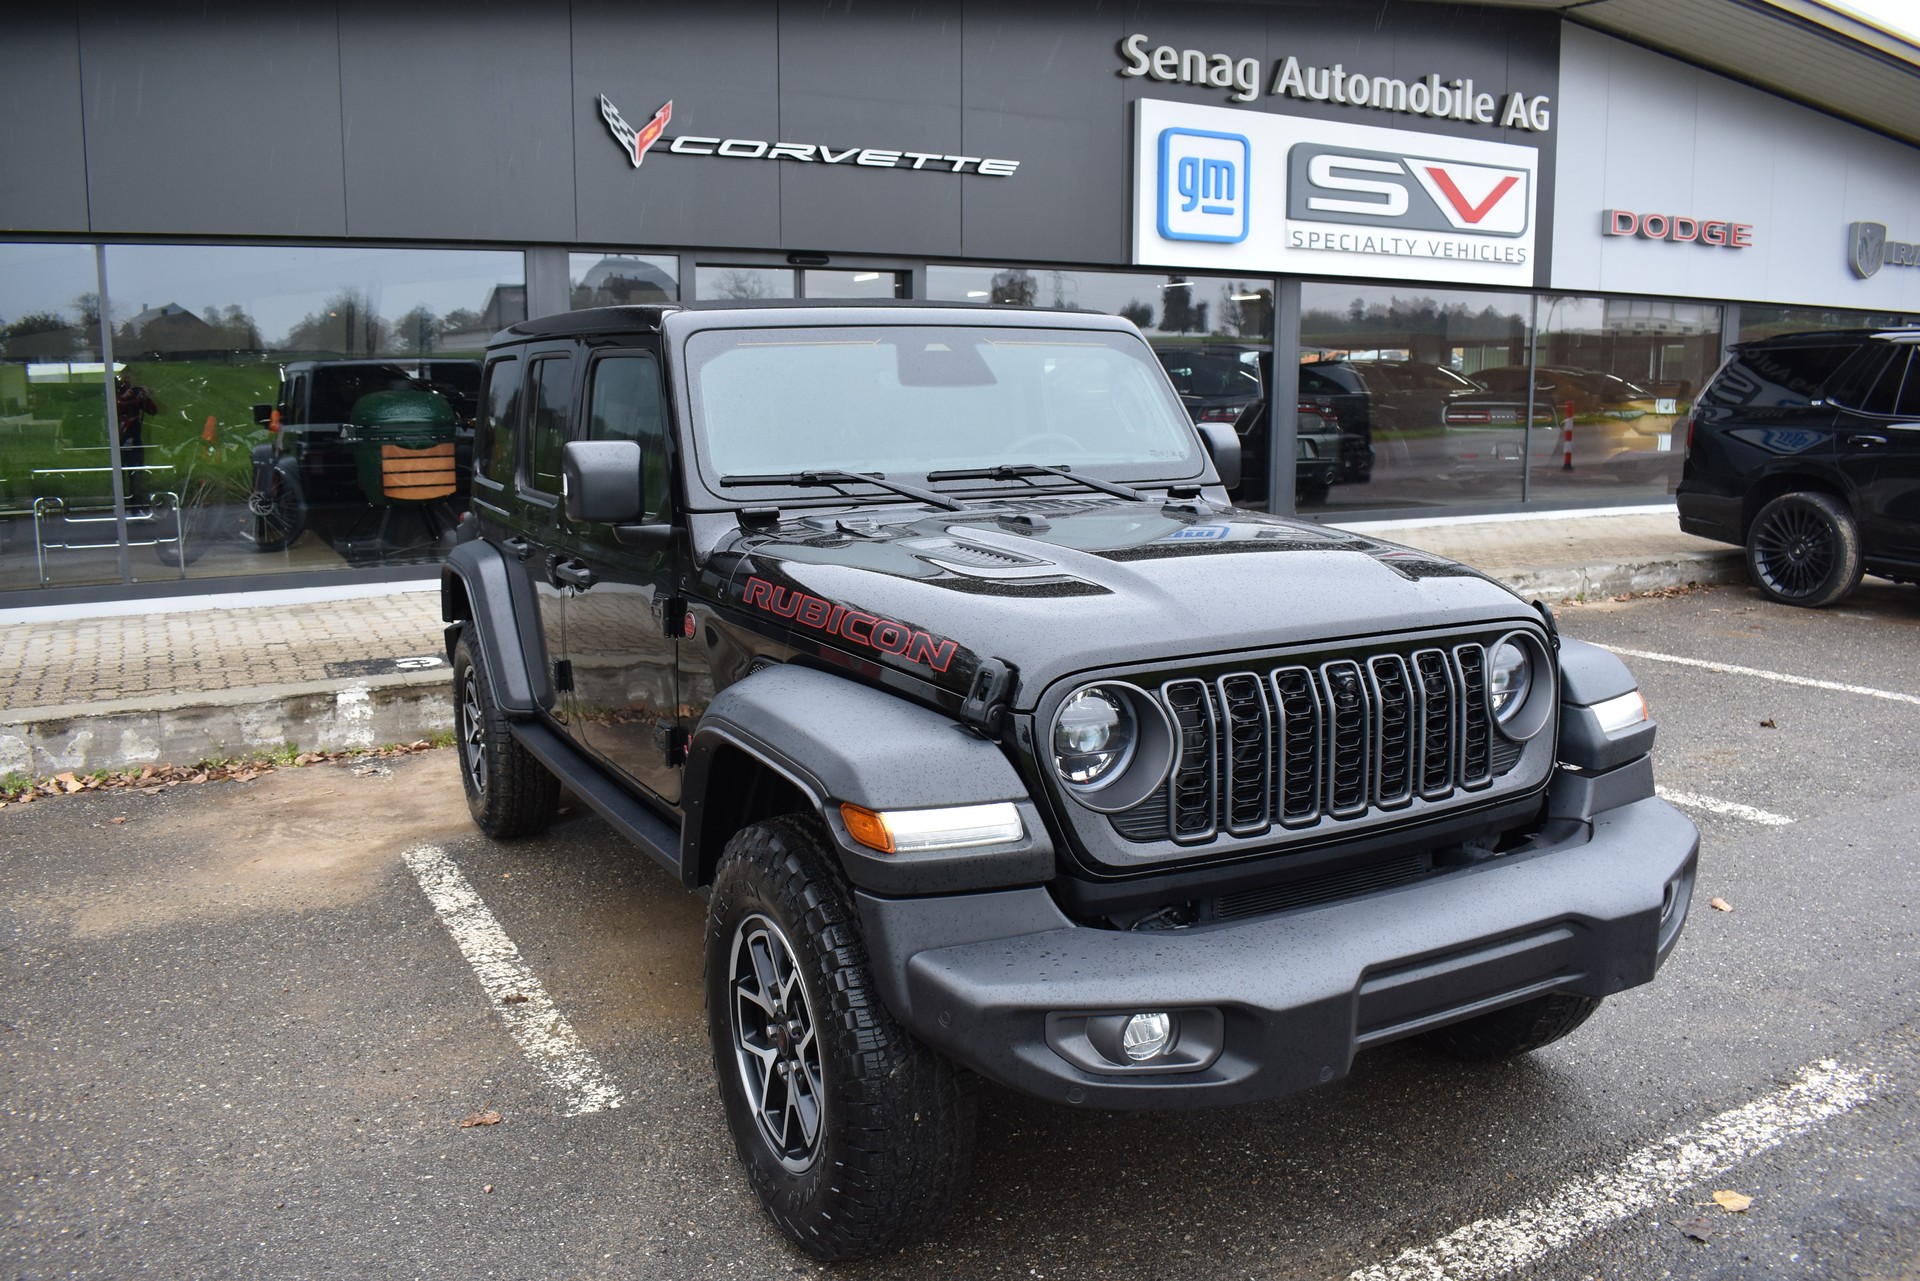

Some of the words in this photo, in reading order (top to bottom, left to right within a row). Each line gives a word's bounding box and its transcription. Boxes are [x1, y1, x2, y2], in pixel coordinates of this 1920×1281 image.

[1126, 33, 1260, 102] Senag
[1276, 56, 1495, 123] Automobile
[1506, 92, 1551, 131] AG
[670, 135, 1021, 176] CORVETTE
[1178, 156, 1236, 213] gm
[1307, 154, 1521, 224] SV
[1292, 230, 1418, 256] SPECIALTY
[1428, 241, 1527, 263] VEHICLES
[1609, 208, 1754, 247] DODGE
[743, 576, 958, 673] RUBICON
